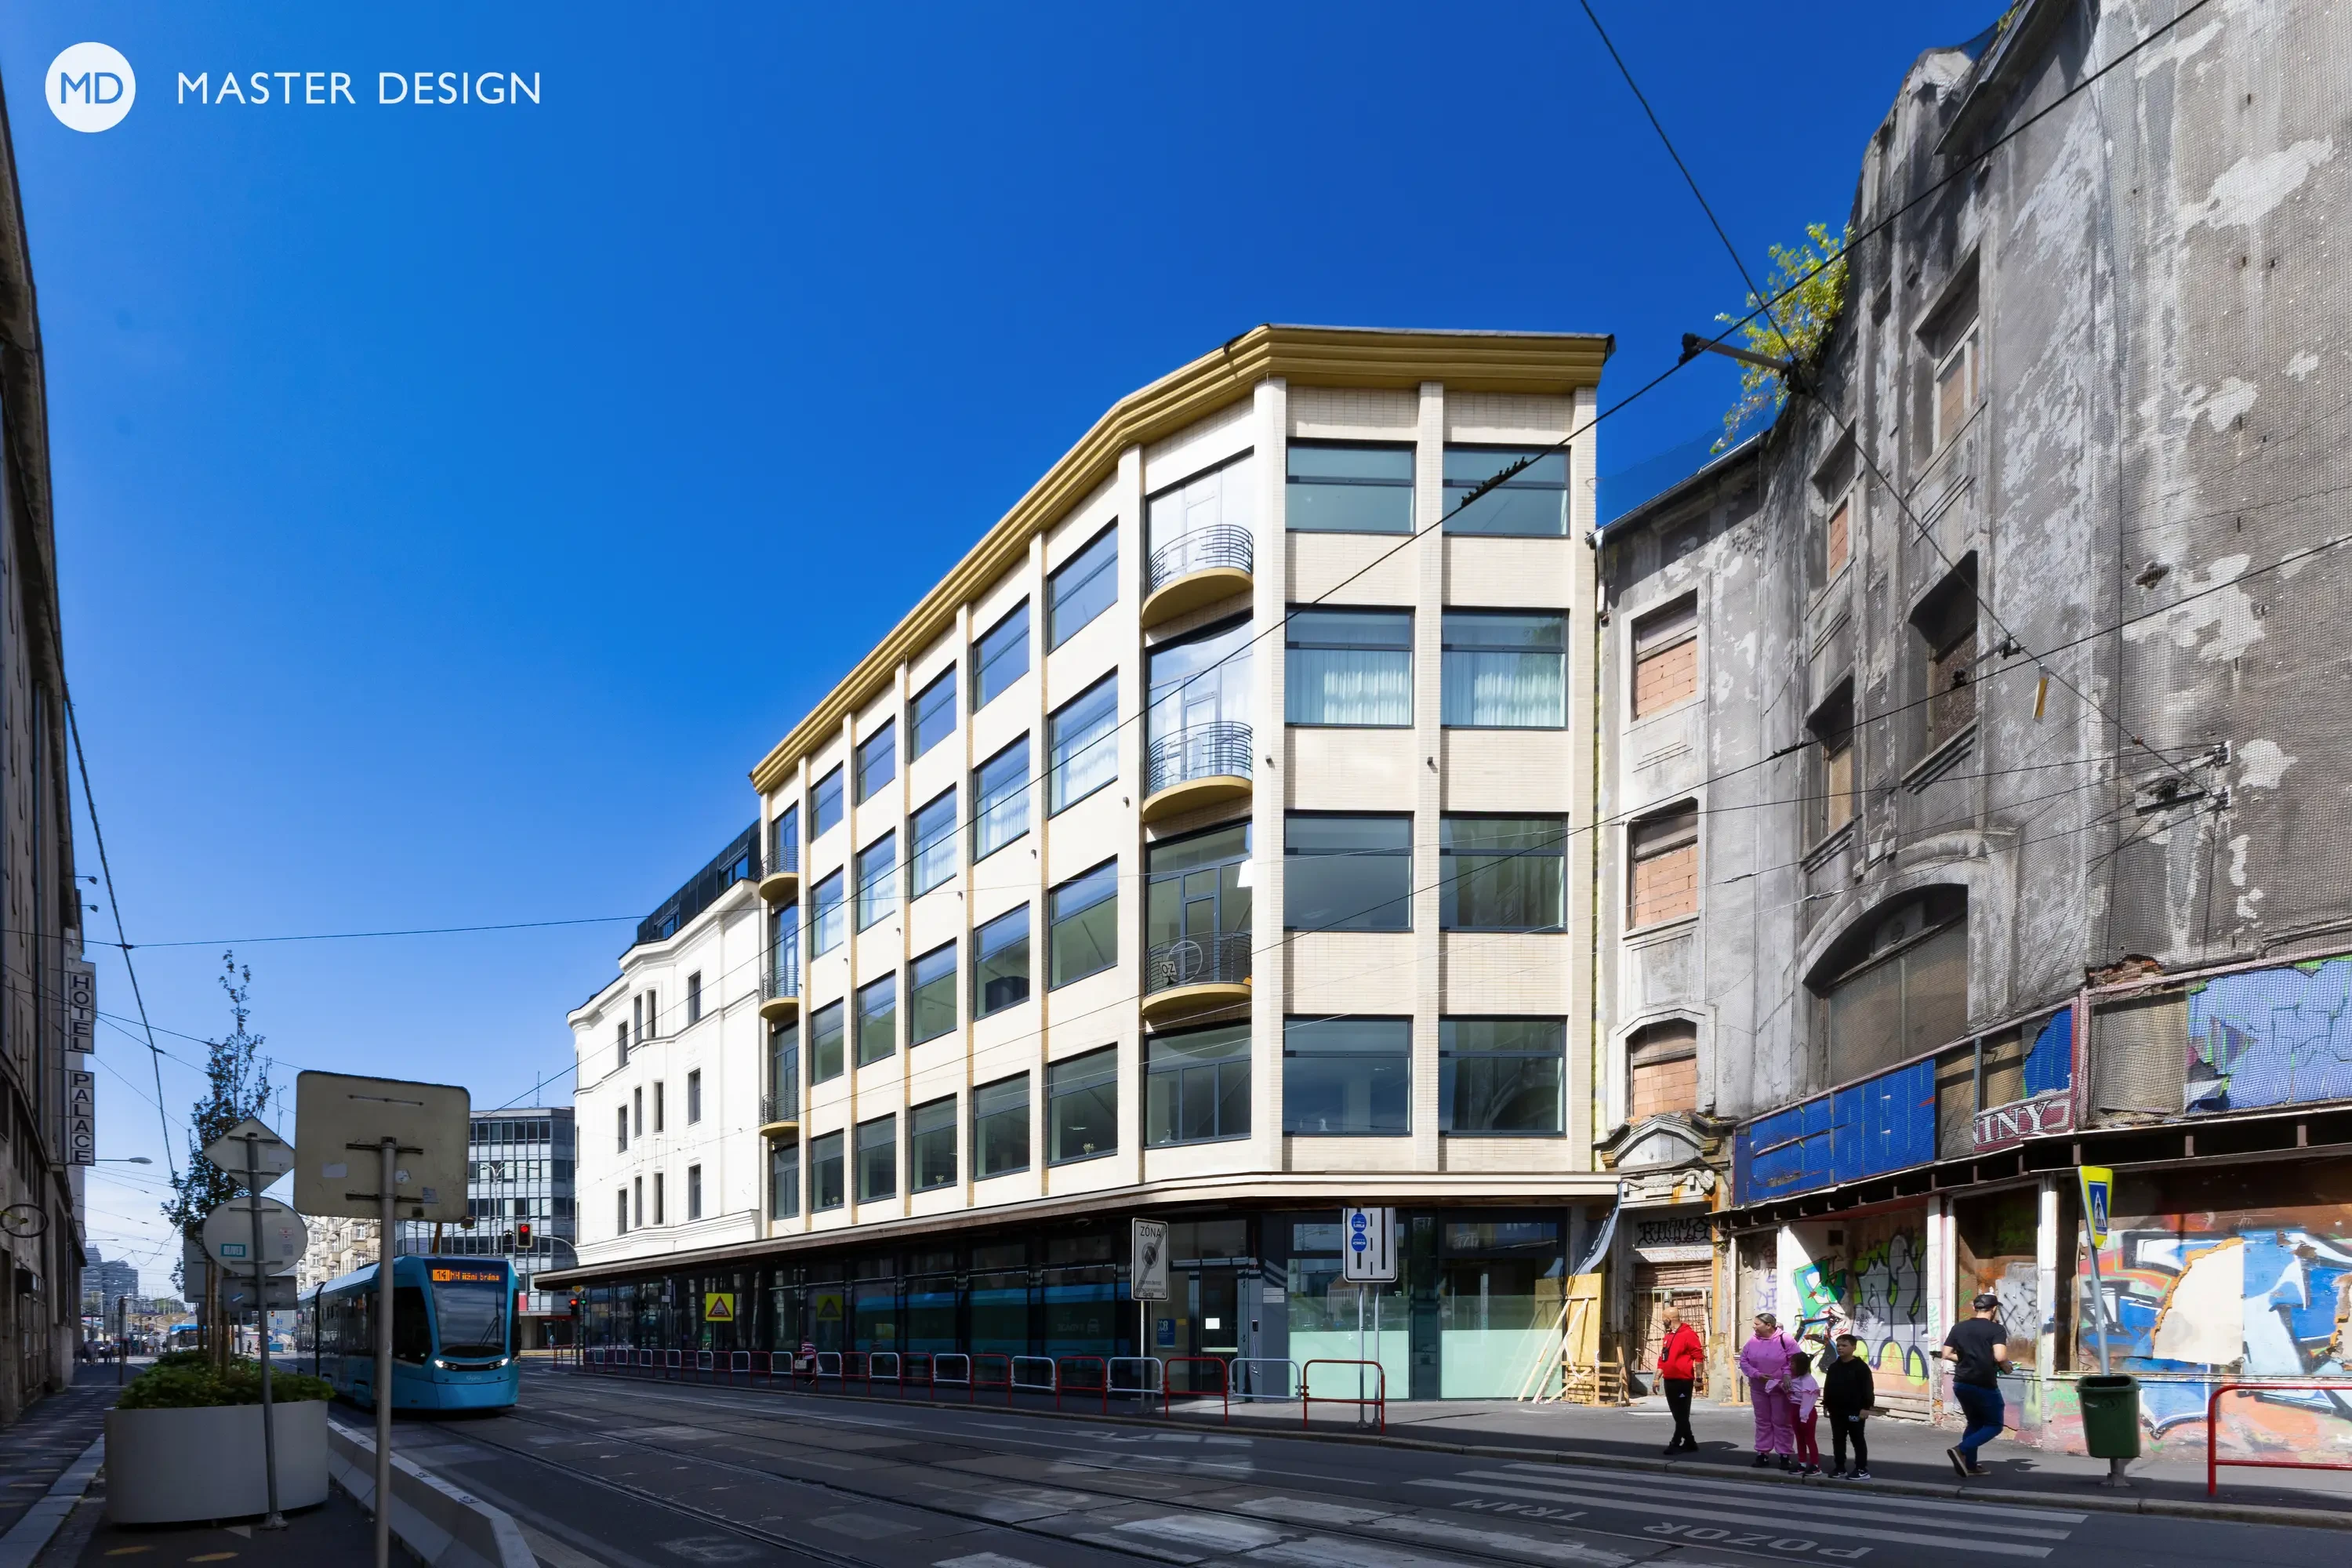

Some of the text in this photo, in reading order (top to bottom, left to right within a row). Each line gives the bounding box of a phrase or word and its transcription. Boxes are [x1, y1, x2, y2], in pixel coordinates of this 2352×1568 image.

[74, 975, 90, 1163] HOTEL PALACE
[1140, 1225, 1161, 1237] ZÓNA
[1450, 1498, 1875, 1559] POZOR TRAM
